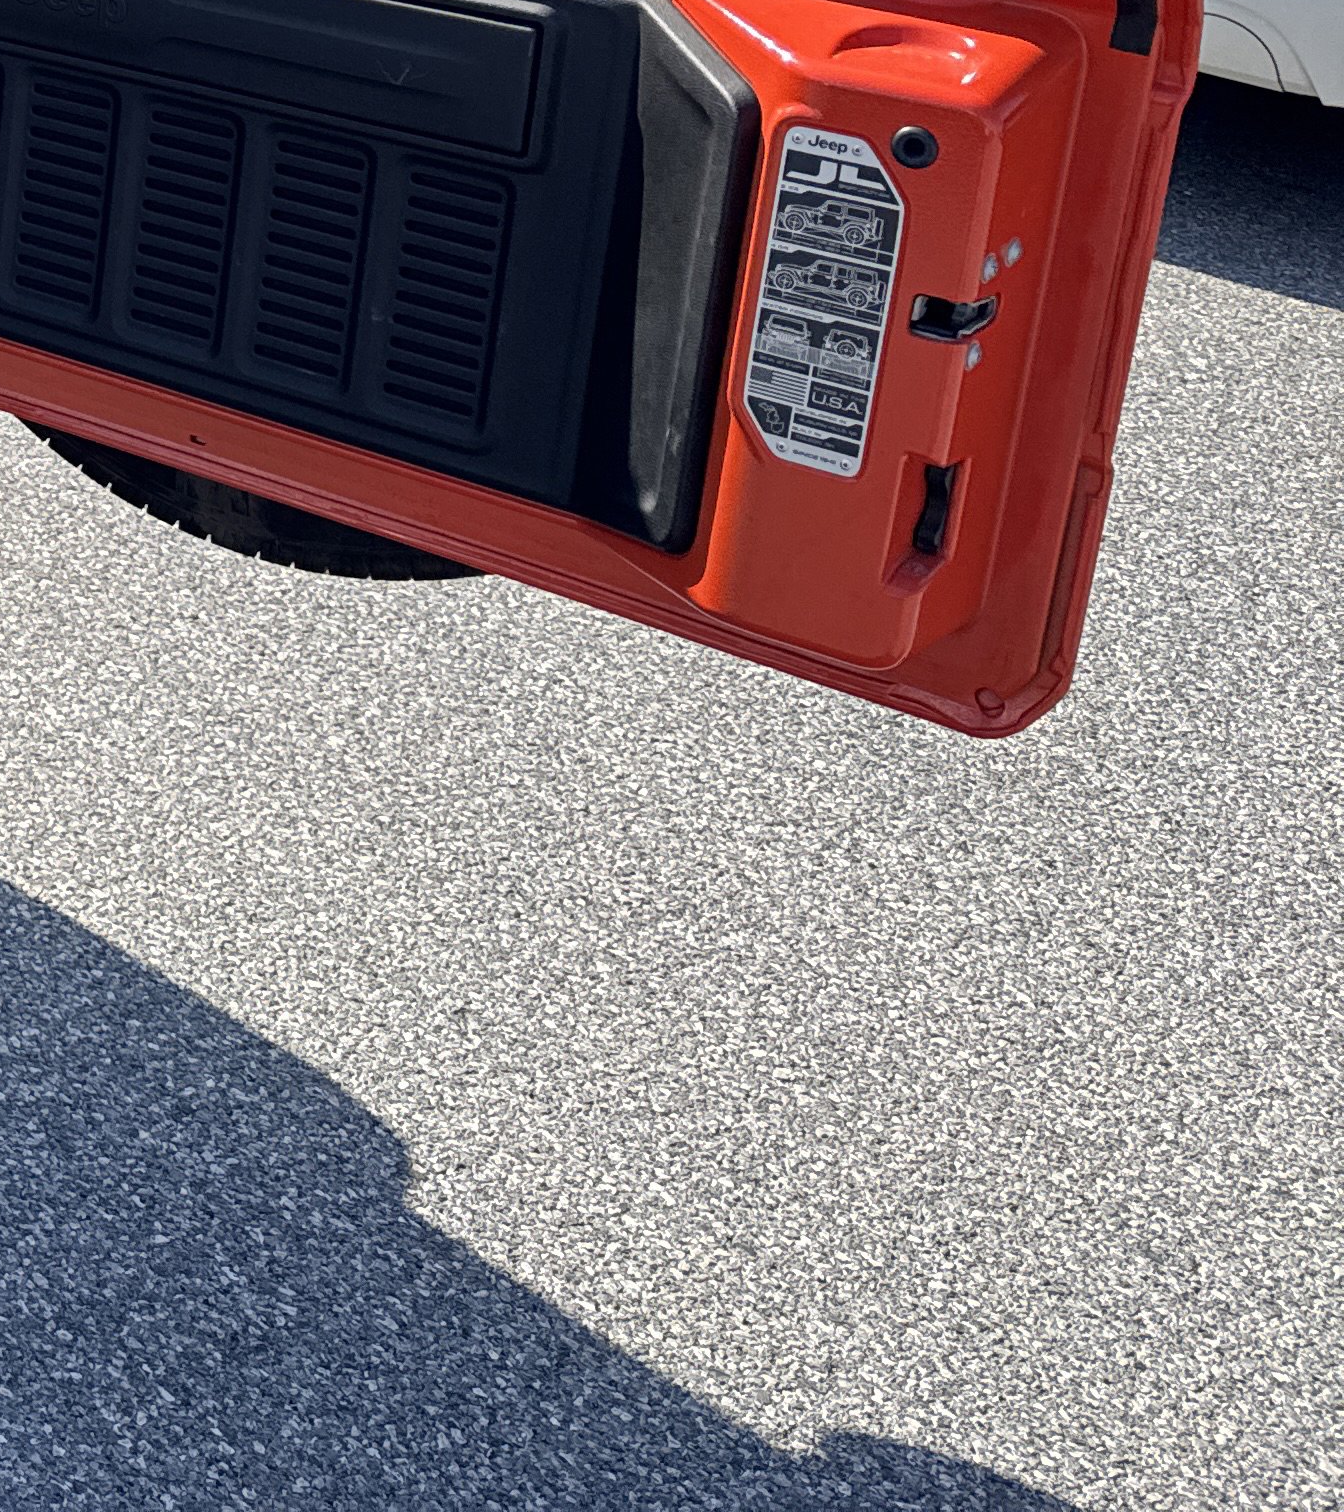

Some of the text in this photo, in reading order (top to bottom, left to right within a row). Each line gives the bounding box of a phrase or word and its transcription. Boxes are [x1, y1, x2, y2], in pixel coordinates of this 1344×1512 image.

[808, 134, 848, 155] Jeep
[785, 159, 887, 192] JL
[811, 391, 864, 416] U.S.A.
